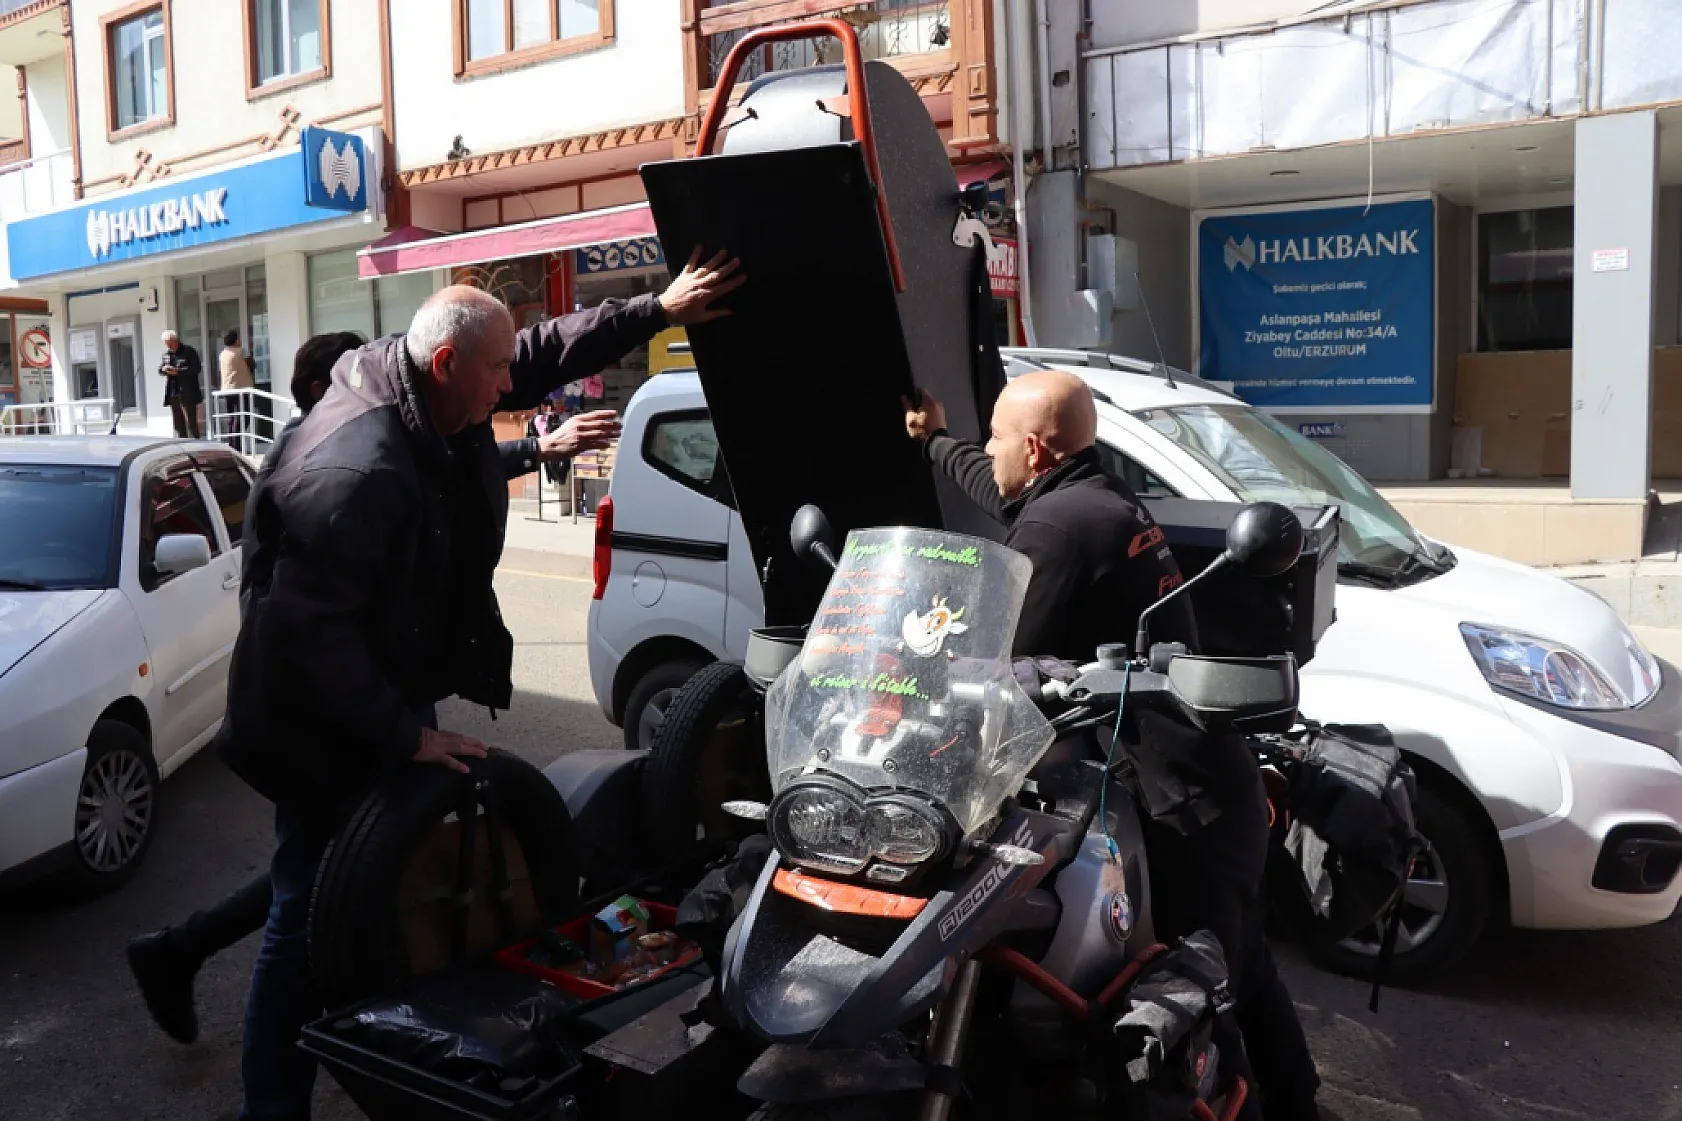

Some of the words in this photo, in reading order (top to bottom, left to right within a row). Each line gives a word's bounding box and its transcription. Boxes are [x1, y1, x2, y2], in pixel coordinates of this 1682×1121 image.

[109, 187, 229, 245] HALKBANK
[1259, 228, 1419, 264] HALKBANK
[1259, 313, 1321, 326] Aslanpaşa
[1323, 309, 1381, 323] Mahallesi
[1245, 331, 1292, 343] Ziyabey
[1295, 328, 1343, 341] Caddesi
[1346, 325, 1398, 340] No:34/A
[1273, 344, 1367, 358] Oltu/ERZURUM
[1336, 376, 1365, 385] devam
[1366, 376, 1417, 385] etmektedir.
